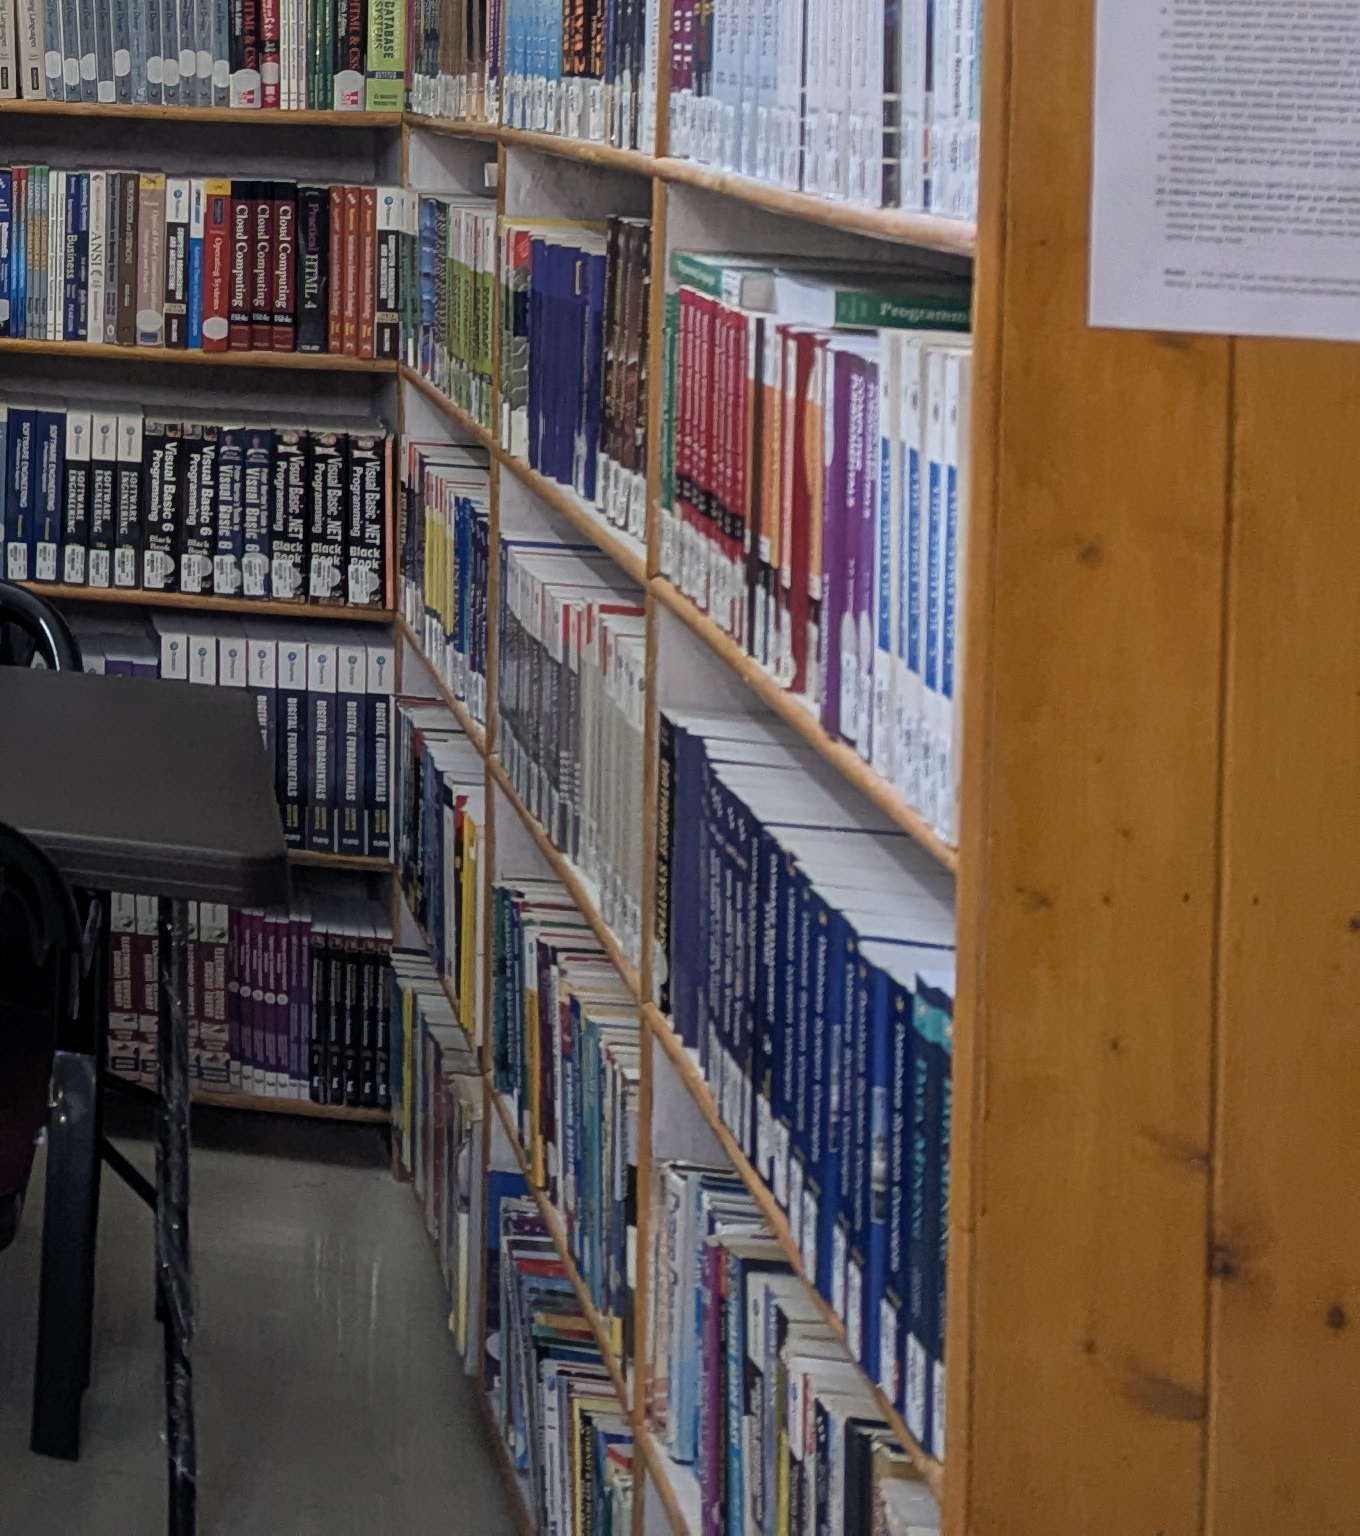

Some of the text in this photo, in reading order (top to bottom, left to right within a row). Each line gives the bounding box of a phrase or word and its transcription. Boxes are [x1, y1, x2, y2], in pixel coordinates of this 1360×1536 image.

[349, 35, 360, 46] &
[374, 1, 383, 50] SYSTEMS
[383, 1, 395, 59] DATABASE
[66, 234, 77, 278] Business
[91, 232, 102, 266] ANSI
[213, 237, 222, 276] Operating
[232, 205, 247, 307] Cloud Computing
[275, 206, 291, 308] Cloud Computing
[305, 254, 318, 298] HTML
[129, 472, 137, 522] SOFTWARE
[149, 450, 163, 521] Programming
[162, 442, 177, 531] Visual Basic 6
[351, 466, 362, 536] Programming
[365, 461, 380, 545] Visual Basic .NET
[316, 701, 327, 799] DIGITAL FUNDAMENTALS
[346, 702, 357, 800] DIGITAL FUNDAMENTALS
